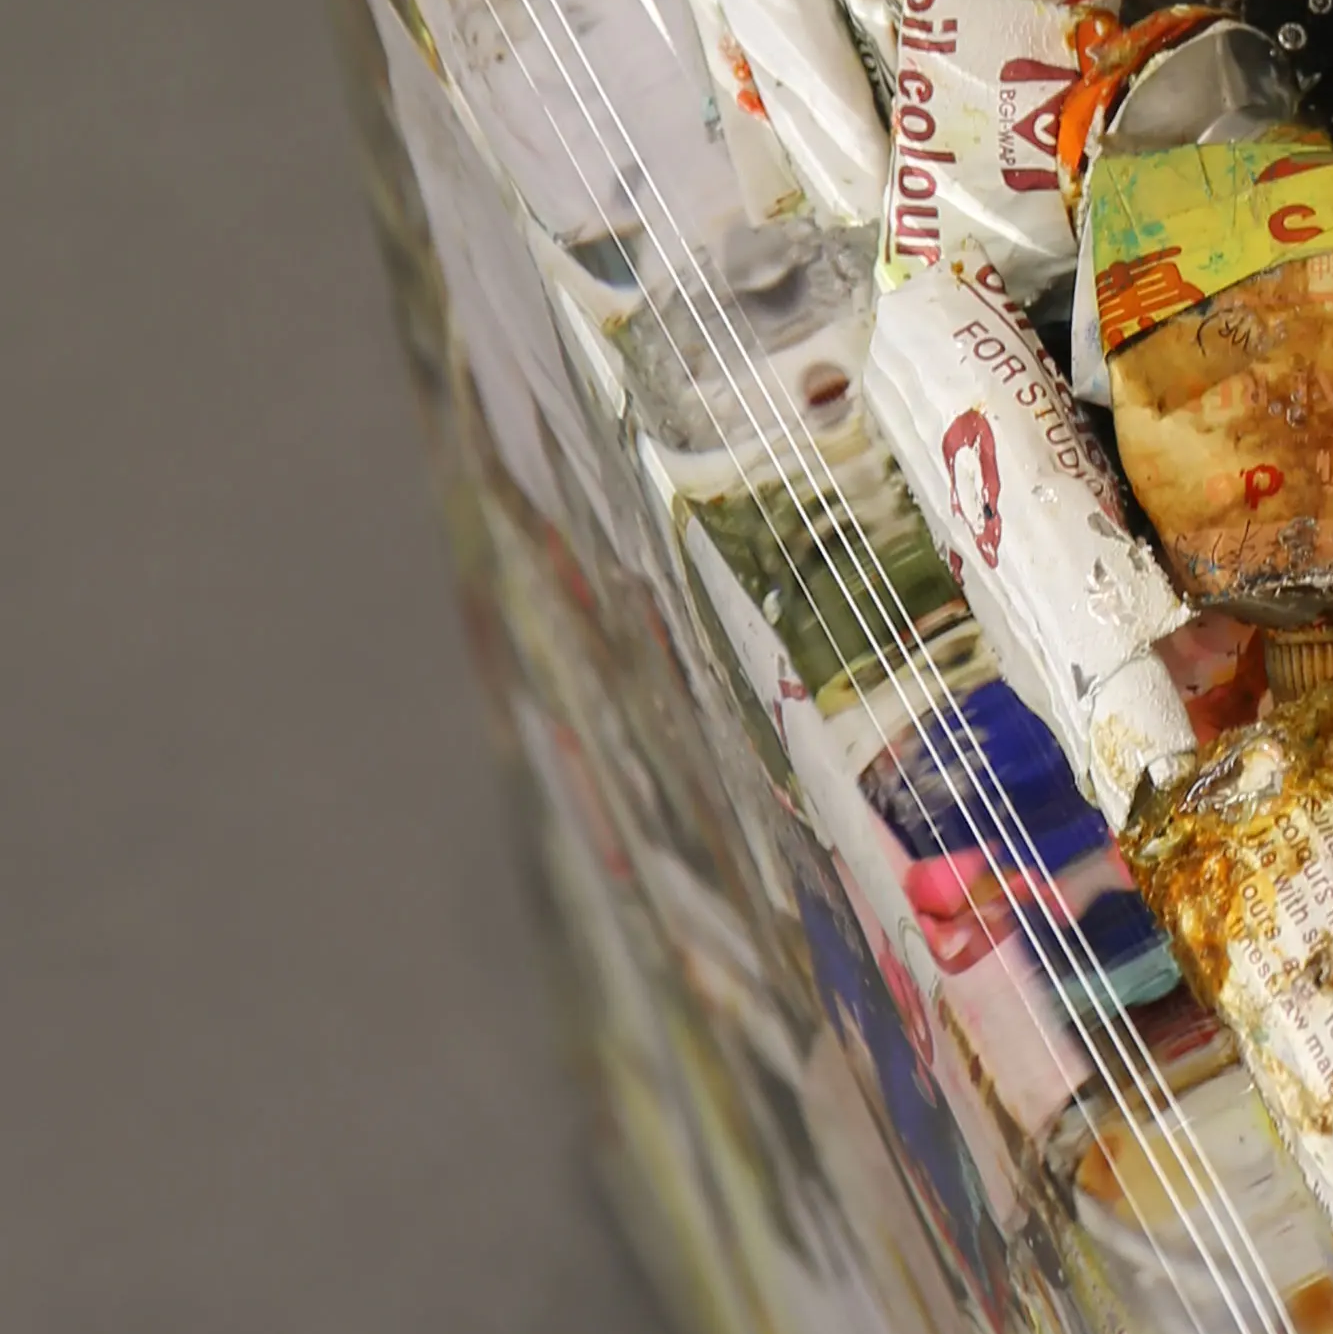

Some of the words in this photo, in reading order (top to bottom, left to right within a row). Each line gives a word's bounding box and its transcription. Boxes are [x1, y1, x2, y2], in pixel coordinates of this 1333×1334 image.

[895, 69, 958, 267] colour
[953, 320, 1027, 383] FOR
[1270, 871, 1314, 926] with
